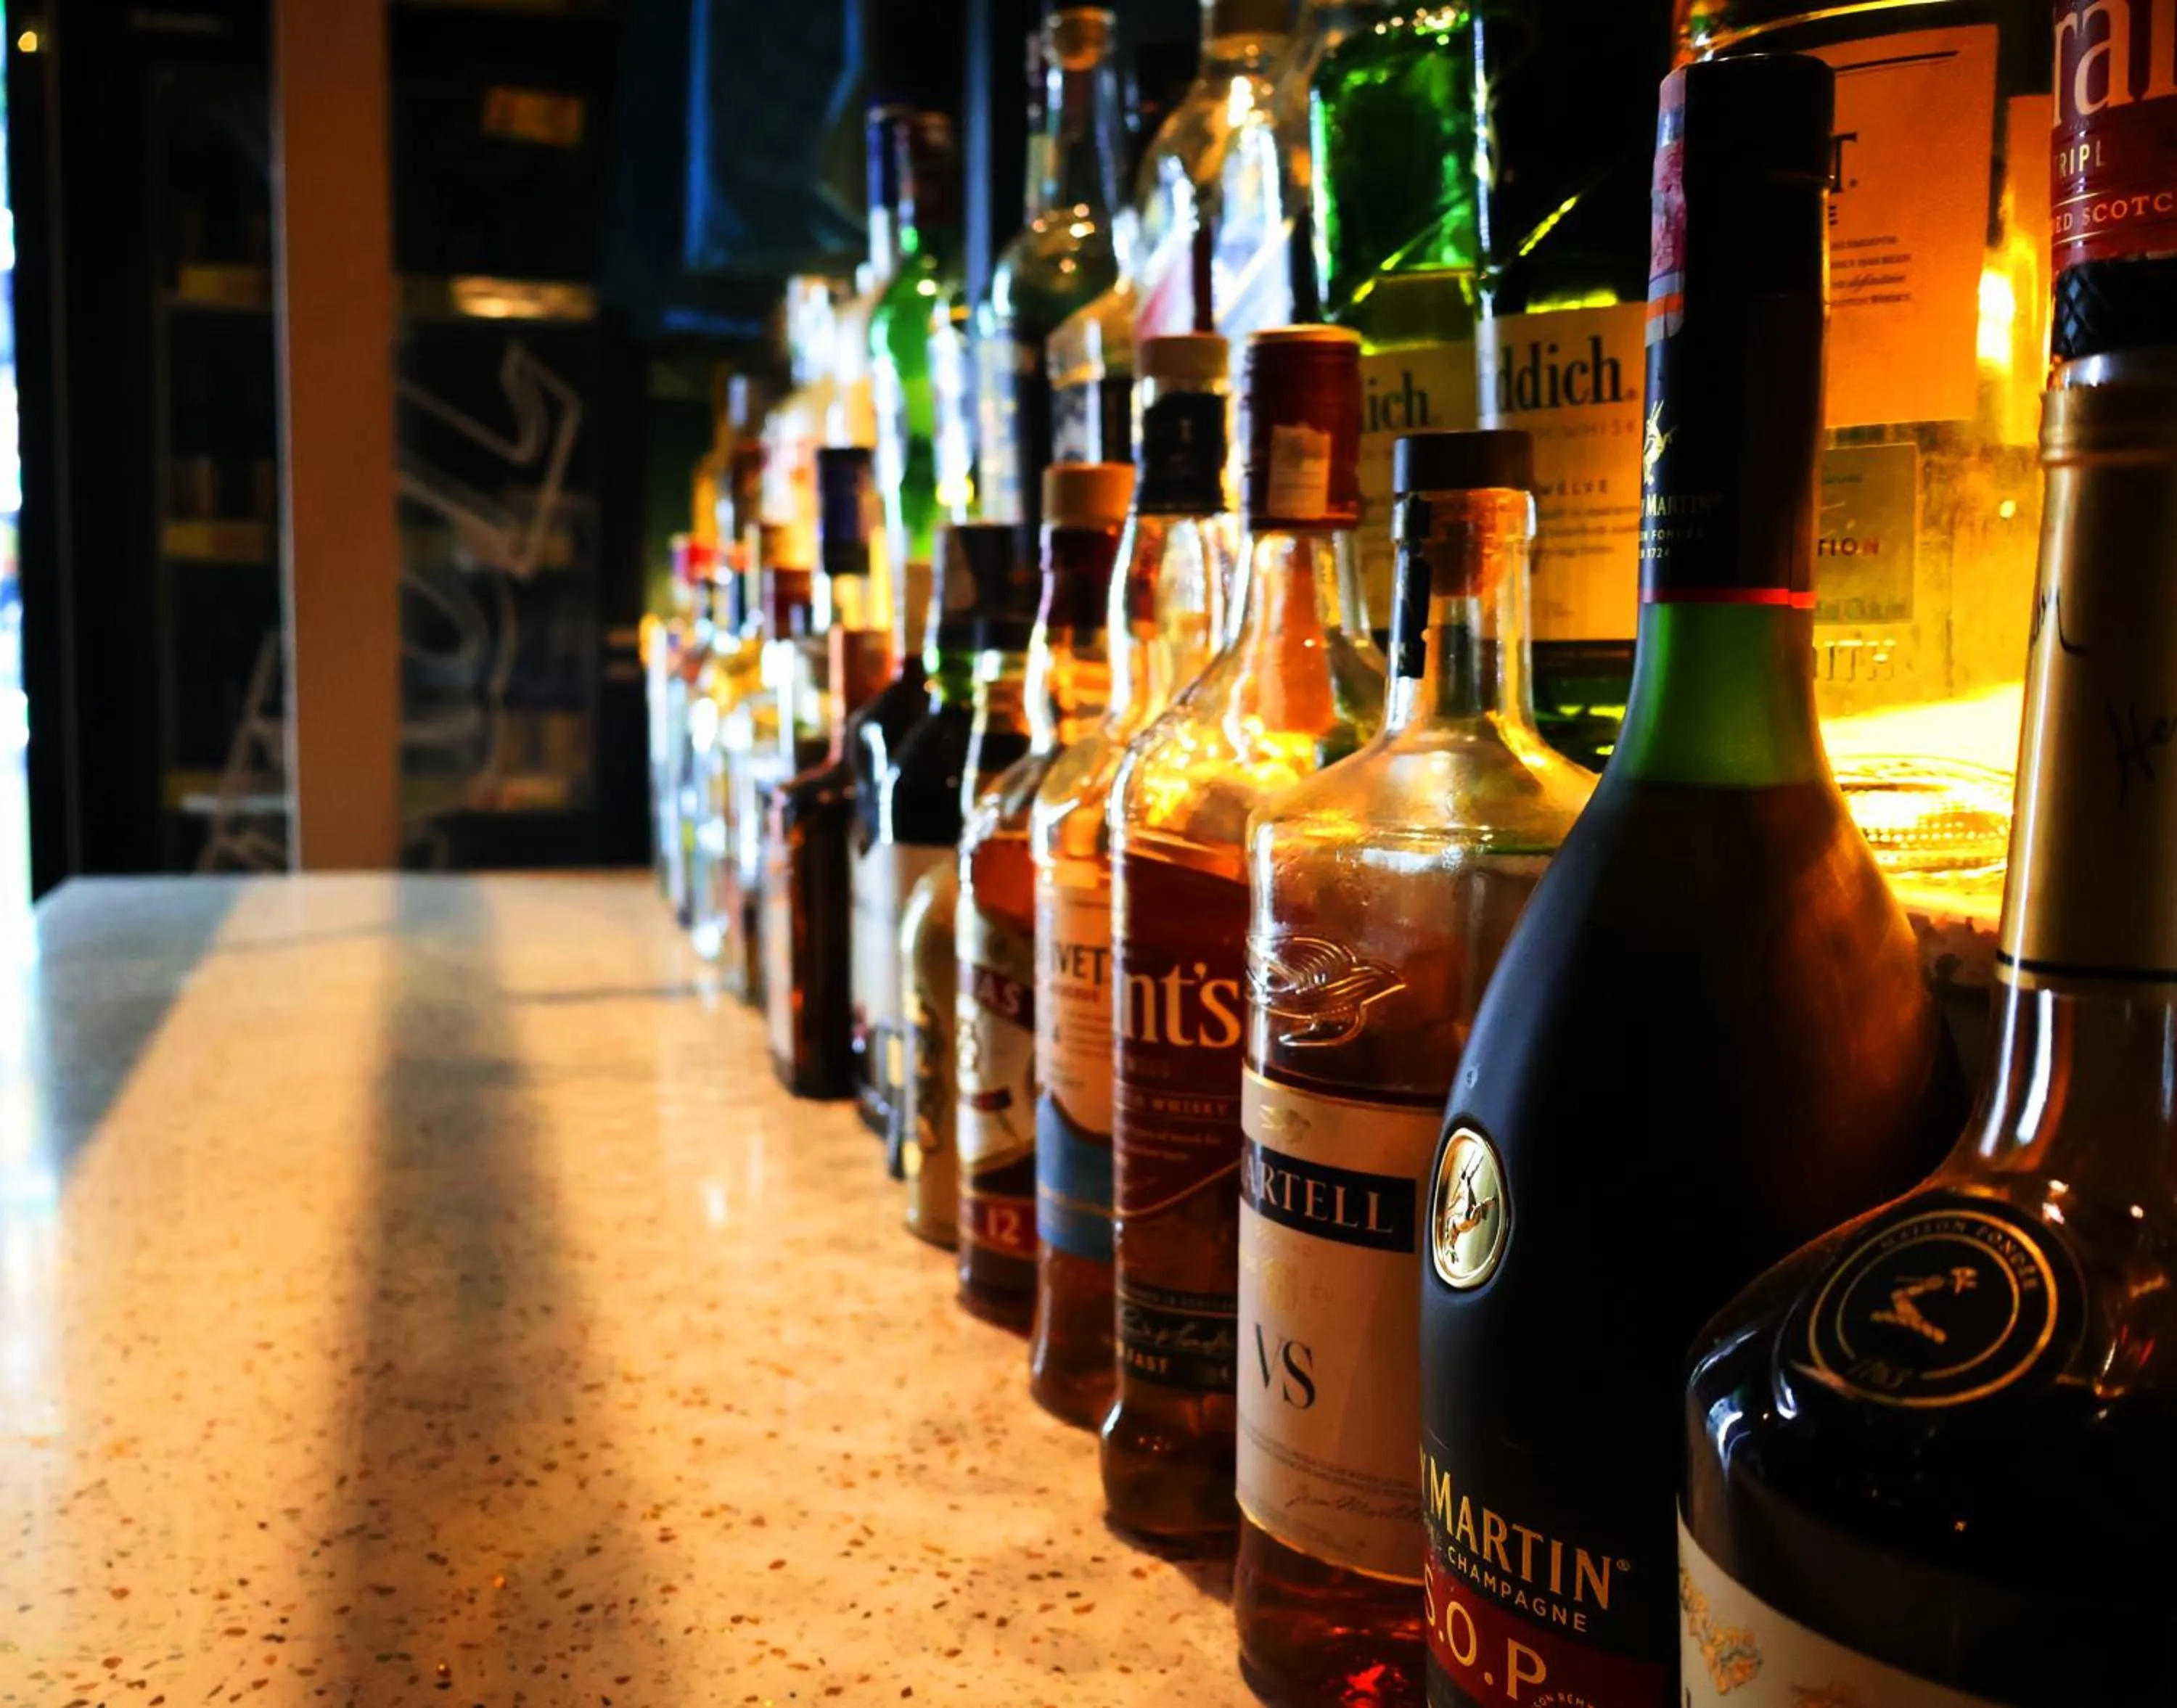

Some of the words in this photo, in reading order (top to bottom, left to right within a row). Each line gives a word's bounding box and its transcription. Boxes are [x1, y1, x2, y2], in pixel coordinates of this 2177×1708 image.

[988, 1205, 1020, 1247] 12
[1255, 1322, 1317, 1410] VS
[1447, 1545, 1587, 1633] CHAMPAGNE
